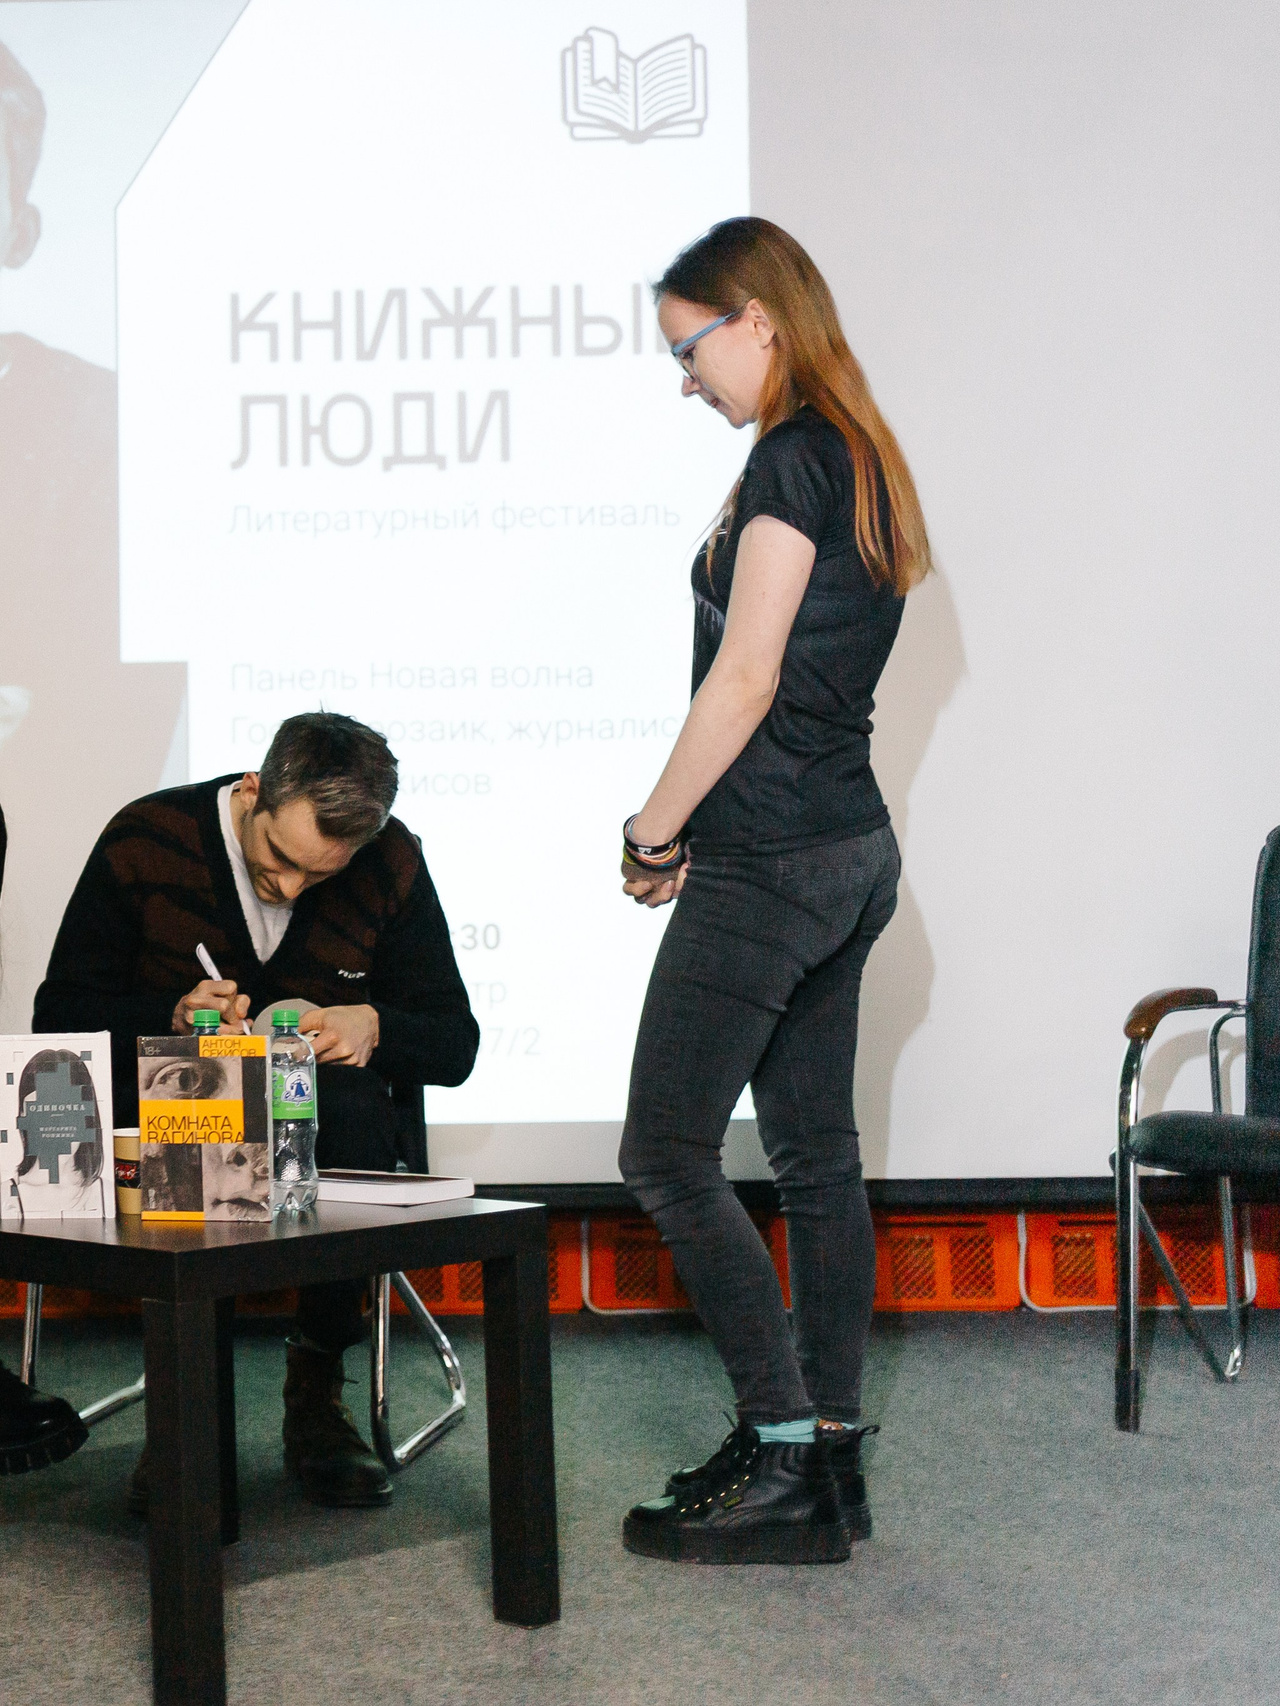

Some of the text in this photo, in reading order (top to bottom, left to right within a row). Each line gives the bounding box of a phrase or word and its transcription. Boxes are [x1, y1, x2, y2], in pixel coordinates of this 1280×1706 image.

[229, 281, 671, 364] КНИЖНЫ
[229, 388, 511, 472] ЛЮДИ
[228, 499, 682, 537] Литературный фестиваль
[231, 661, 594, 692] Панель Новая волна
[506, 714, 685, 748] журналис
[143, 1045, 162, 1056] 18+
[201, 1038, 241, 1049] АНТОН
[201, 1048, 256, 1058] СЕКИСОВ
[480, 1026, 542, 1057] 7/2
[29, 1103, 86, 1113] ОДИНОЧКА
[146, 1115, 233, 1131] КОМНАТА
[146, 1130, 245, 1145] ВАГИНОВА
